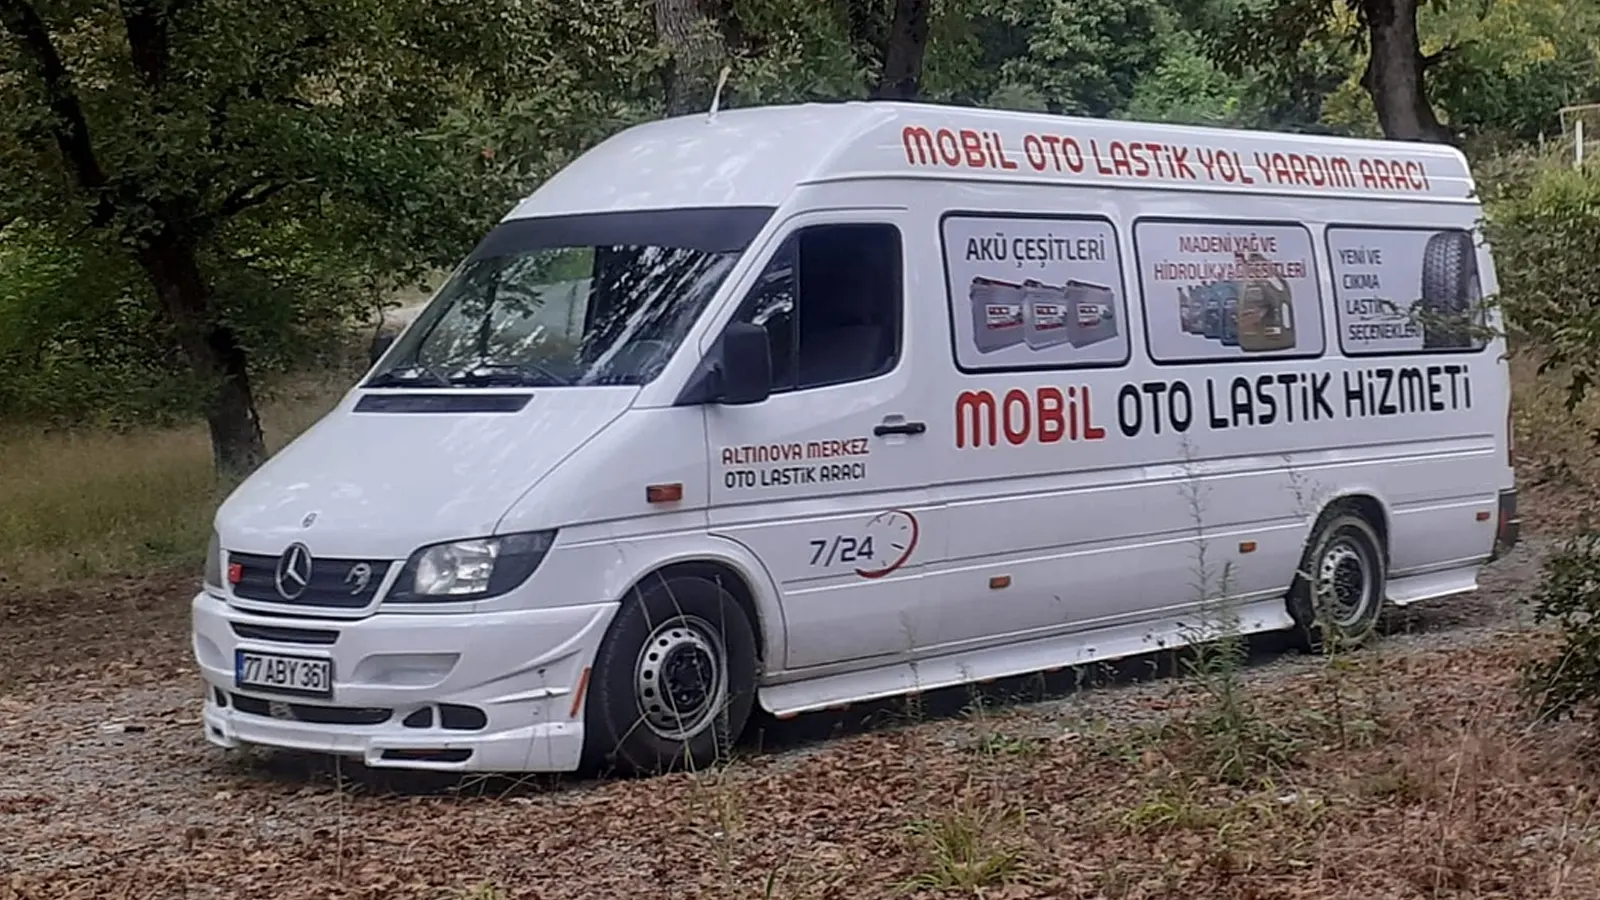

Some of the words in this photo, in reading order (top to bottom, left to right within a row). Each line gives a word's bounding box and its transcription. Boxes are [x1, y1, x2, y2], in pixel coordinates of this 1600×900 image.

[1024, 135, 1084, 172] OTO
[1197, 148, 1253, 184] YOL
[1254, 152, 1356, 187] YARDIM
[1359, 158, 1430, 190] ARACI
[966, 233, 1007, 260] AKÜ
[1013, 233, 1106, 268] ÇEŞİTLERİ
[1260, 236, 1277, 252] VE
[1366, 249, 1382, 264] VE
[1118, 381, 1192, 437] OTO
[722, 443, 802, 465] ALTINOVA
[807, 438, 869, 459] MERKEZ
[725, 471, 756, 488] OTO
[820, 463, 865, 482] ARACI
[810, 535, 874, 567] 7/24
[244, 656, 262, 682] 77
[265, 659, 298, 685] ABY
